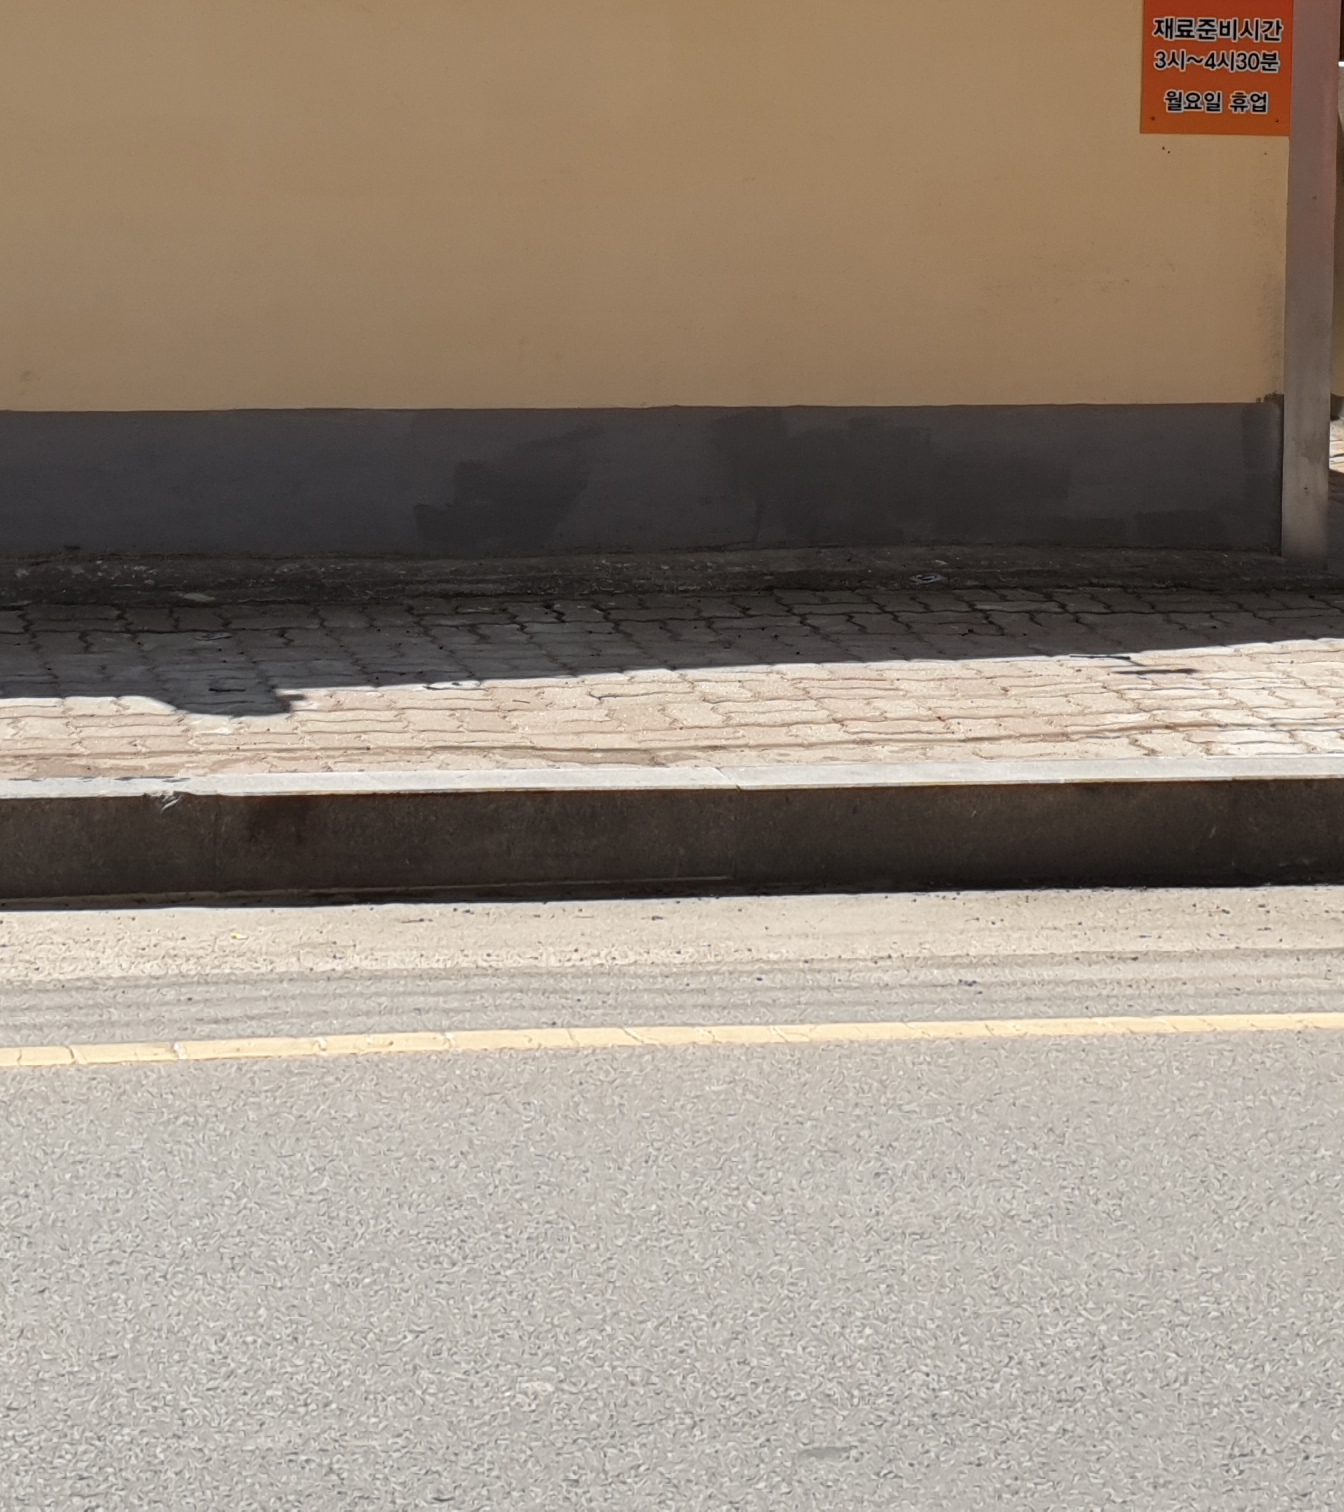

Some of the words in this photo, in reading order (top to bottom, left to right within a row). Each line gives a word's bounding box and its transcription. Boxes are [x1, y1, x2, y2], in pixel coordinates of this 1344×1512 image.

[1153, 17, 1282, 41] 재료준비시간
[1154, 50, 1280, 74] 3시~4시30분
[1164, 89, 1222, 112] 월요일
[1229, 91, 1269, 114] 휴업
